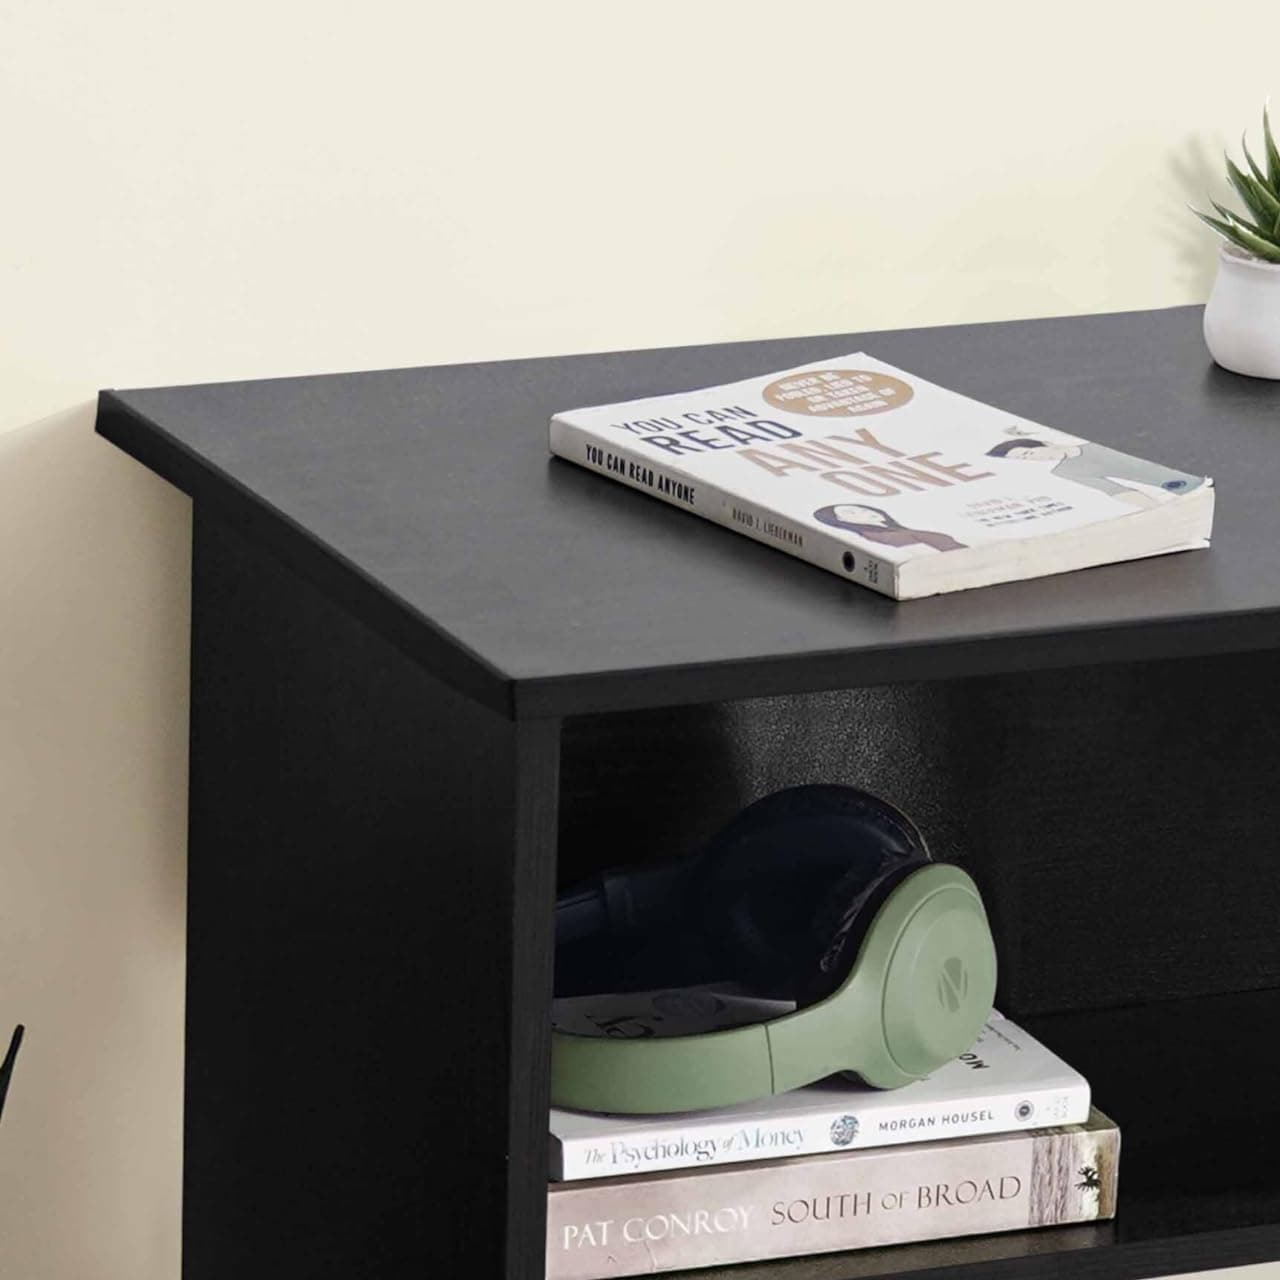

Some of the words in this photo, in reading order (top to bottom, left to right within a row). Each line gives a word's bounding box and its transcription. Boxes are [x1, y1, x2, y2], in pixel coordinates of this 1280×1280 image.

[610, 417, 684, 435] YOU
[682, 405, 758, 425] CAN
[640, 420, 804, 455] READ
[586, 444, 603, 466] YOU
[607, 453, 625, 475] CAN
[629, 462, 654, 487] READ
[658, 474, 695, 505] ANYONE
[736, 428, 908, 477] ANY
[820, 451, 997, 497] ONE
[879, 1116, 936, 1132] MORGAN
[941, 1110, 995, 1125] HOUSEL
[610, 1136, 718, 1168] Psychology
[738, 1126, 806, 1150] Money
[771, 1191, 872, 1226] SOUTH
[881, 1193, 909, 1211] OF
[917, 1174, 1022, 1209] BROAD
[562, 1220, 613, 1250] PAT
[622, 1204, 754, 1243] CONROY
